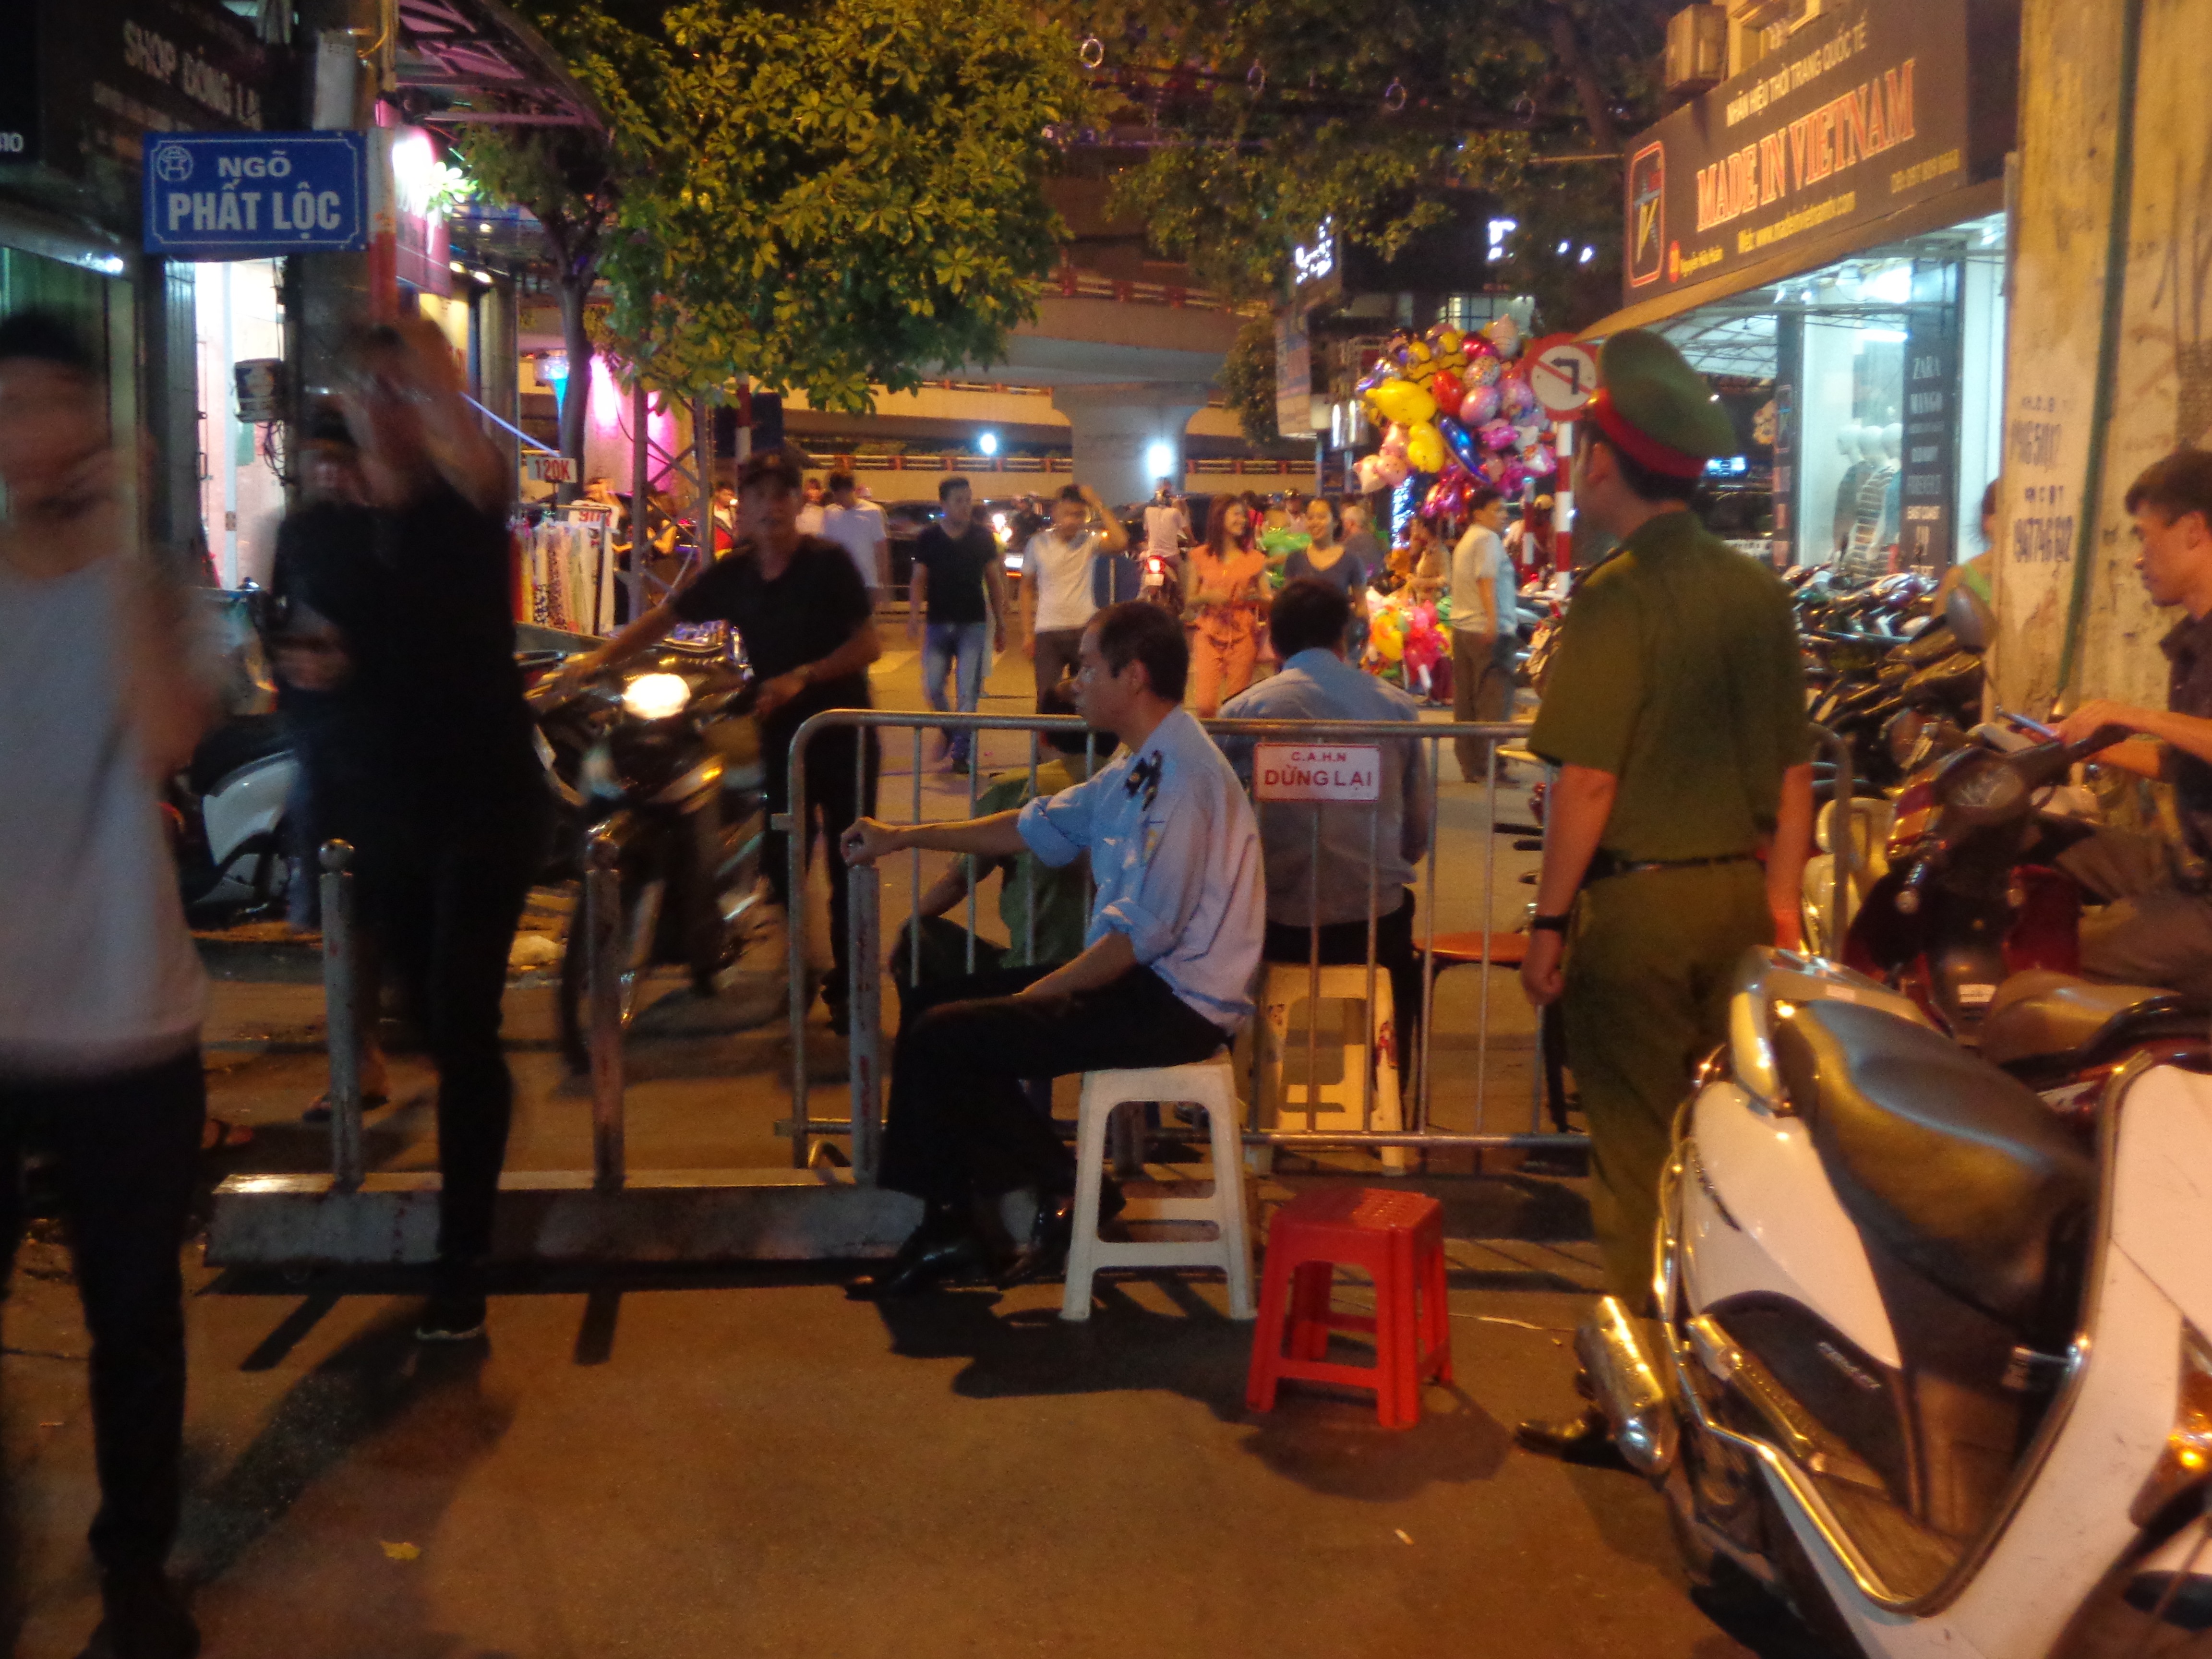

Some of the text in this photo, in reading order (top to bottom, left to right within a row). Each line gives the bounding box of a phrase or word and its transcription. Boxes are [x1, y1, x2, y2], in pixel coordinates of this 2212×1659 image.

[1696, 143, 1758, 233] MADE
[1759, 127, 1787, 206] IN
[1788, 58, 1916, 192] VIETNAM
[217, 149, 292, 178] NGÕ
[168, 177, 341, 240] PHẤT LỘC
[535, 459, 571, 480] 120K
[1290, 751, 1347, 762] C.A.H.N
[1264, 764, 1372, 791] DỪNG LẠI
